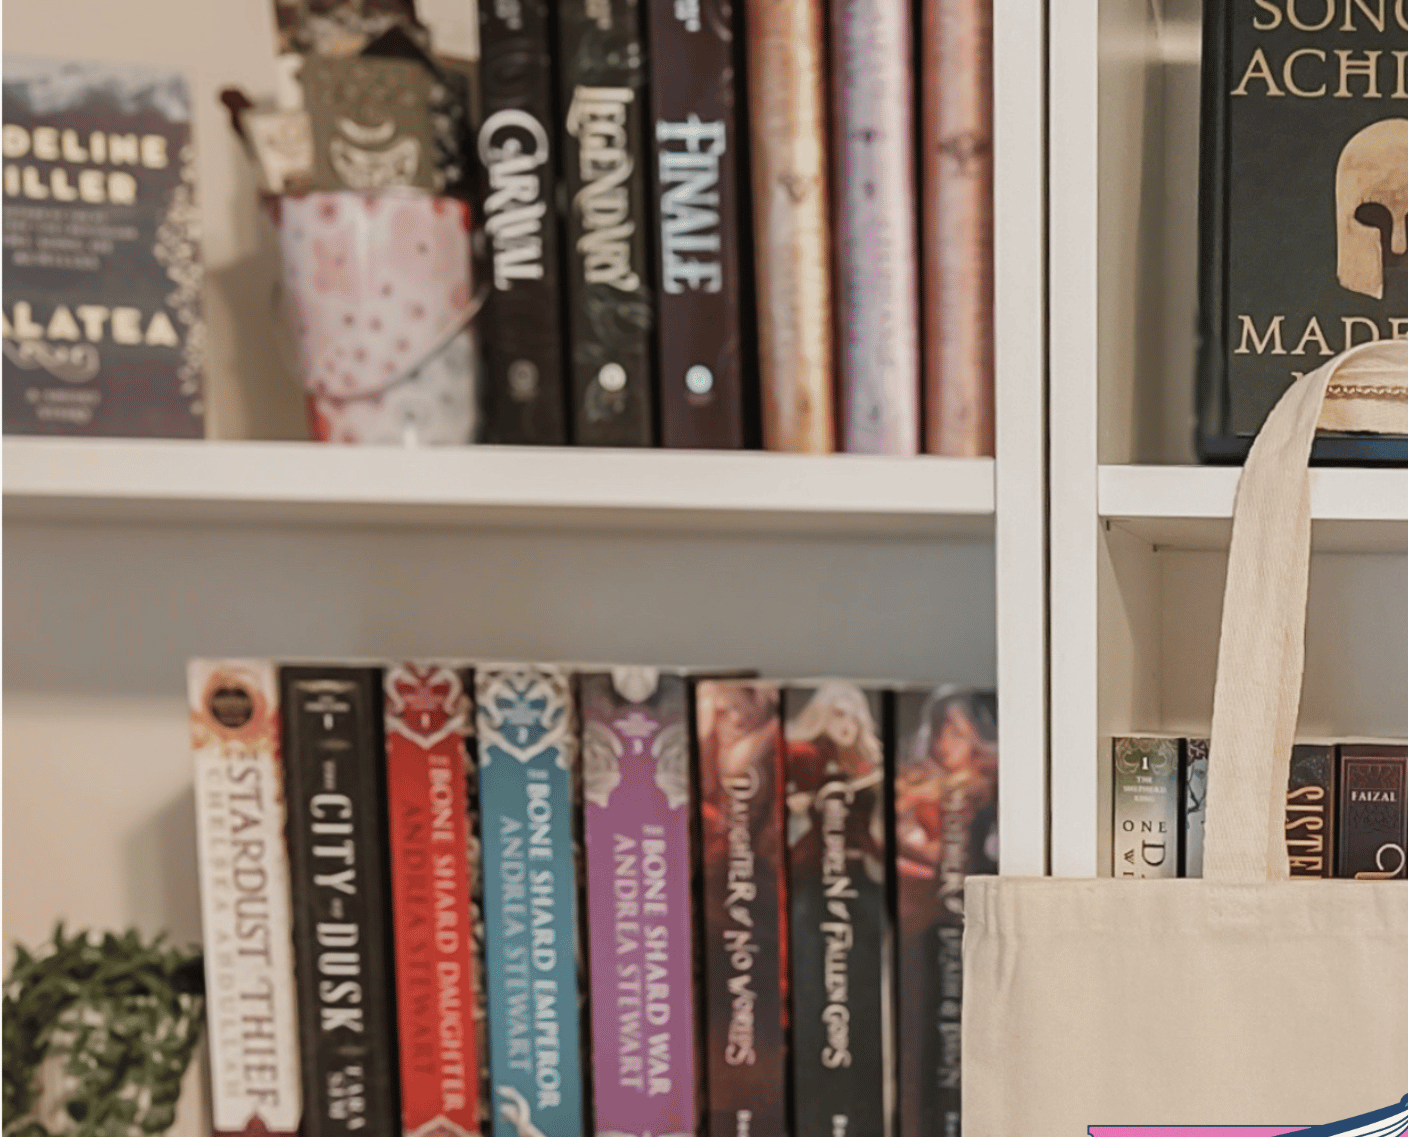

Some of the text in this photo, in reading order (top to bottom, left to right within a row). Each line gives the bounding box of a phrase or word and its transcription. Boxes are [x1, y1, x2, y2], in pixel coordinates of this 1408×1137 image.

[656, 113, 726, 295] FINALE
[1122, 820, 1168, 833] ONE
[227, 763, 279, 1107] STARDUST THIEF
[310, 793, 364, 1033] CITY DUSK
[433, 854, 460, 954] SHARD
[499, 815, 534, 1075] ANDREA STEWART
[528, 869, 557, 973] SHARD
[613, 832, 645, 1092] ANDREA STEWART
[643, 924, 671, 1026] SHARD
[533, 978, 562, 1110] EMPEROR
[646, 1031, 673, 1097] WAR
